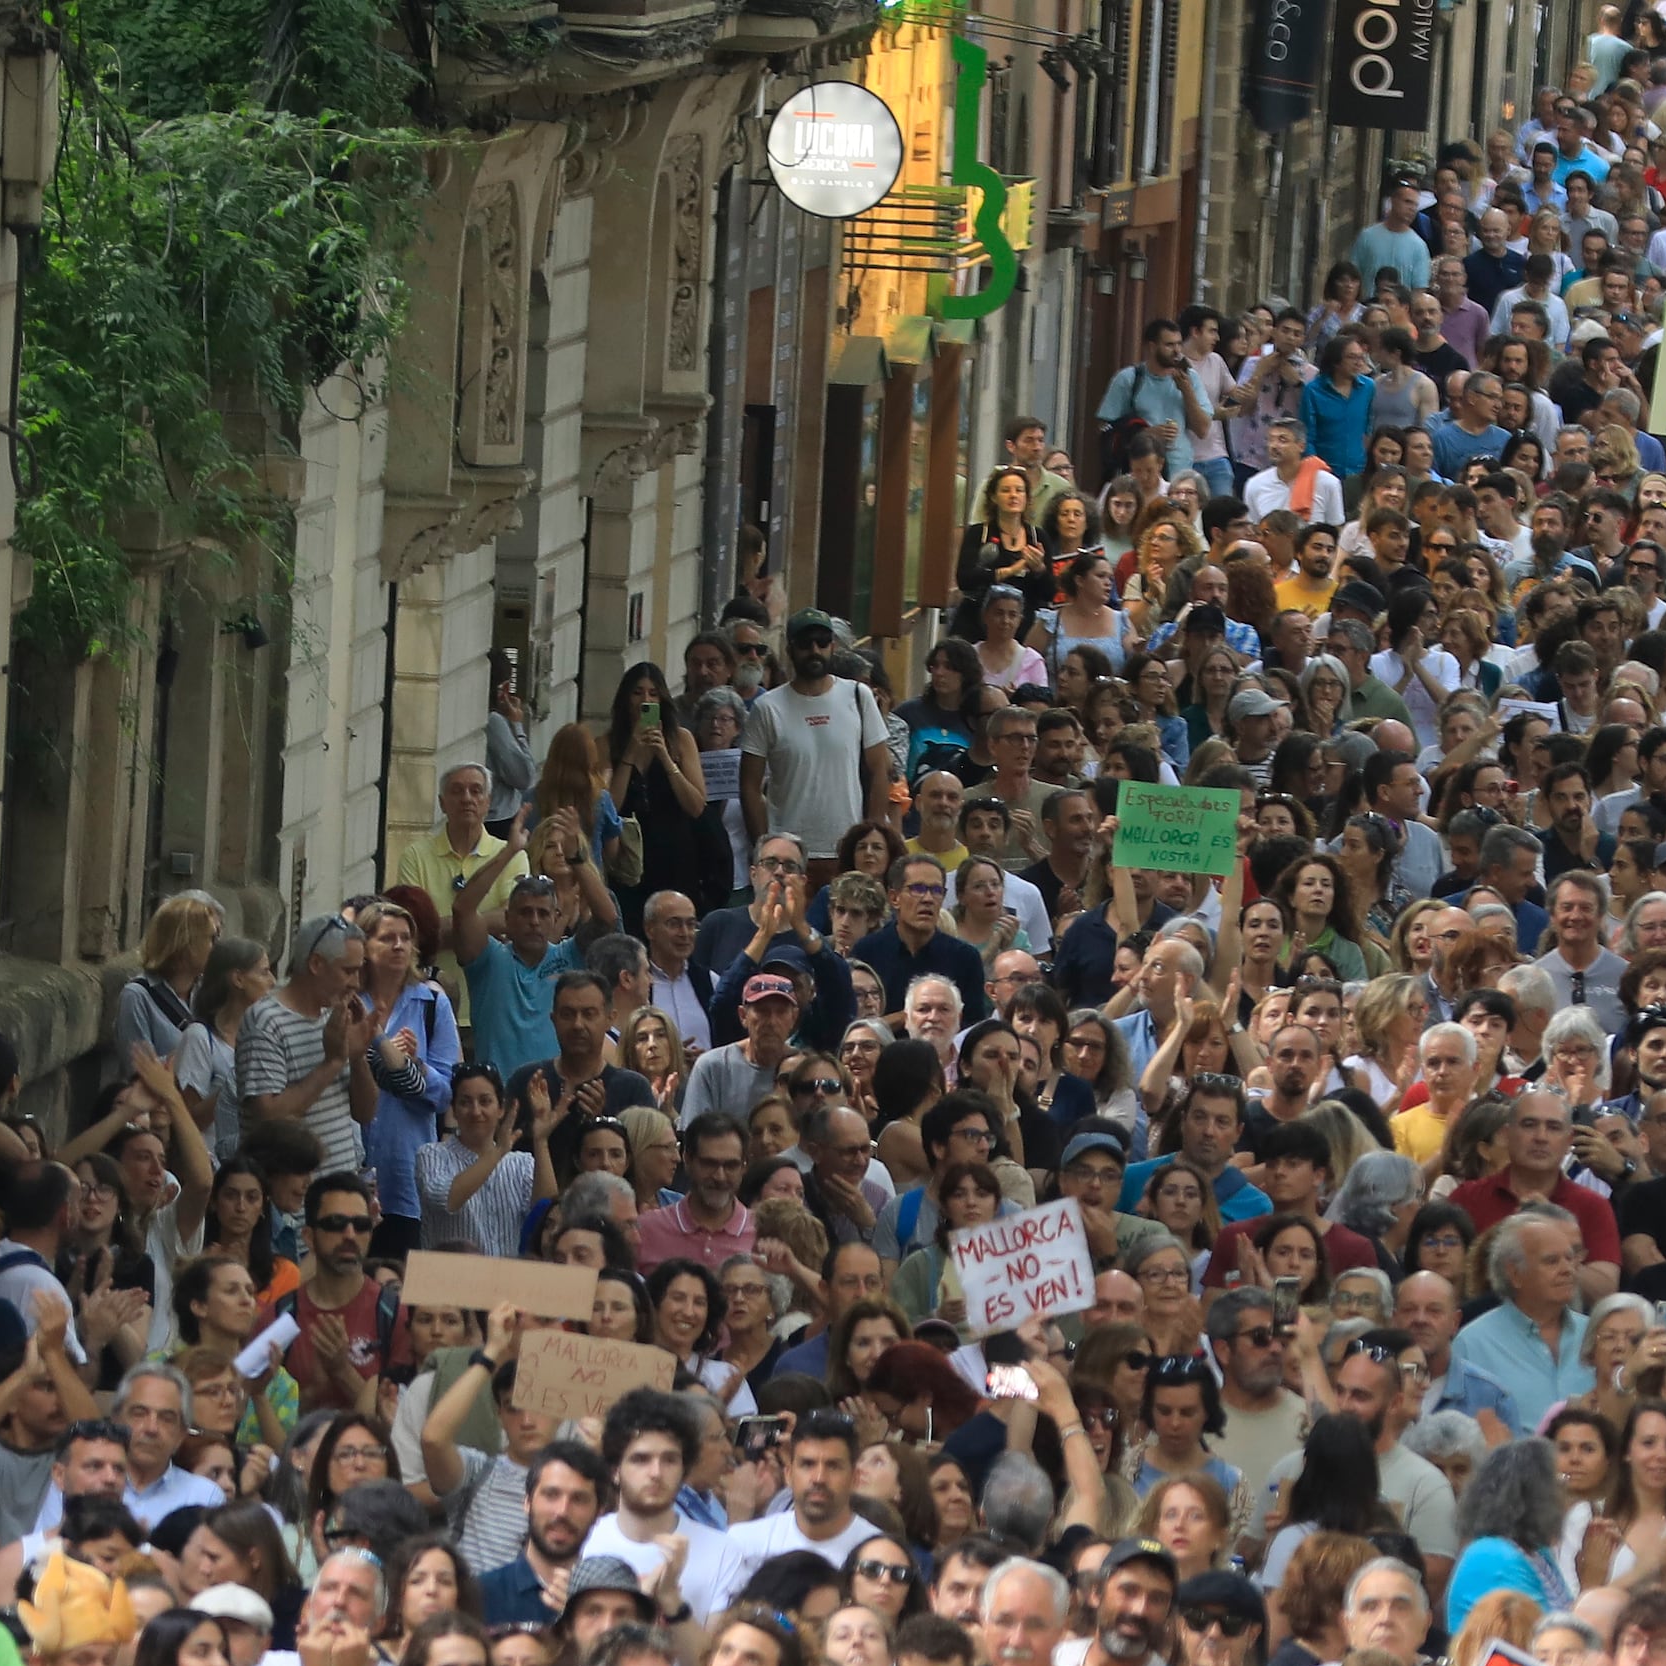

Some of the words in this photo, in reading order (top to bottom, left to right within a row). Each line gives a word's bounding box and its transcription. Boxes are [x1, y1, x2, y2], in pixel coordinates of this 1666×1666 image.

[1121, 825, 1200, 847] MALLORCA
[957, 1209, 1075, 1270] MALLORCA
[985, 1292, 1015, 1325] ES
[543, 1334, 639, 1375] MALLORCA
